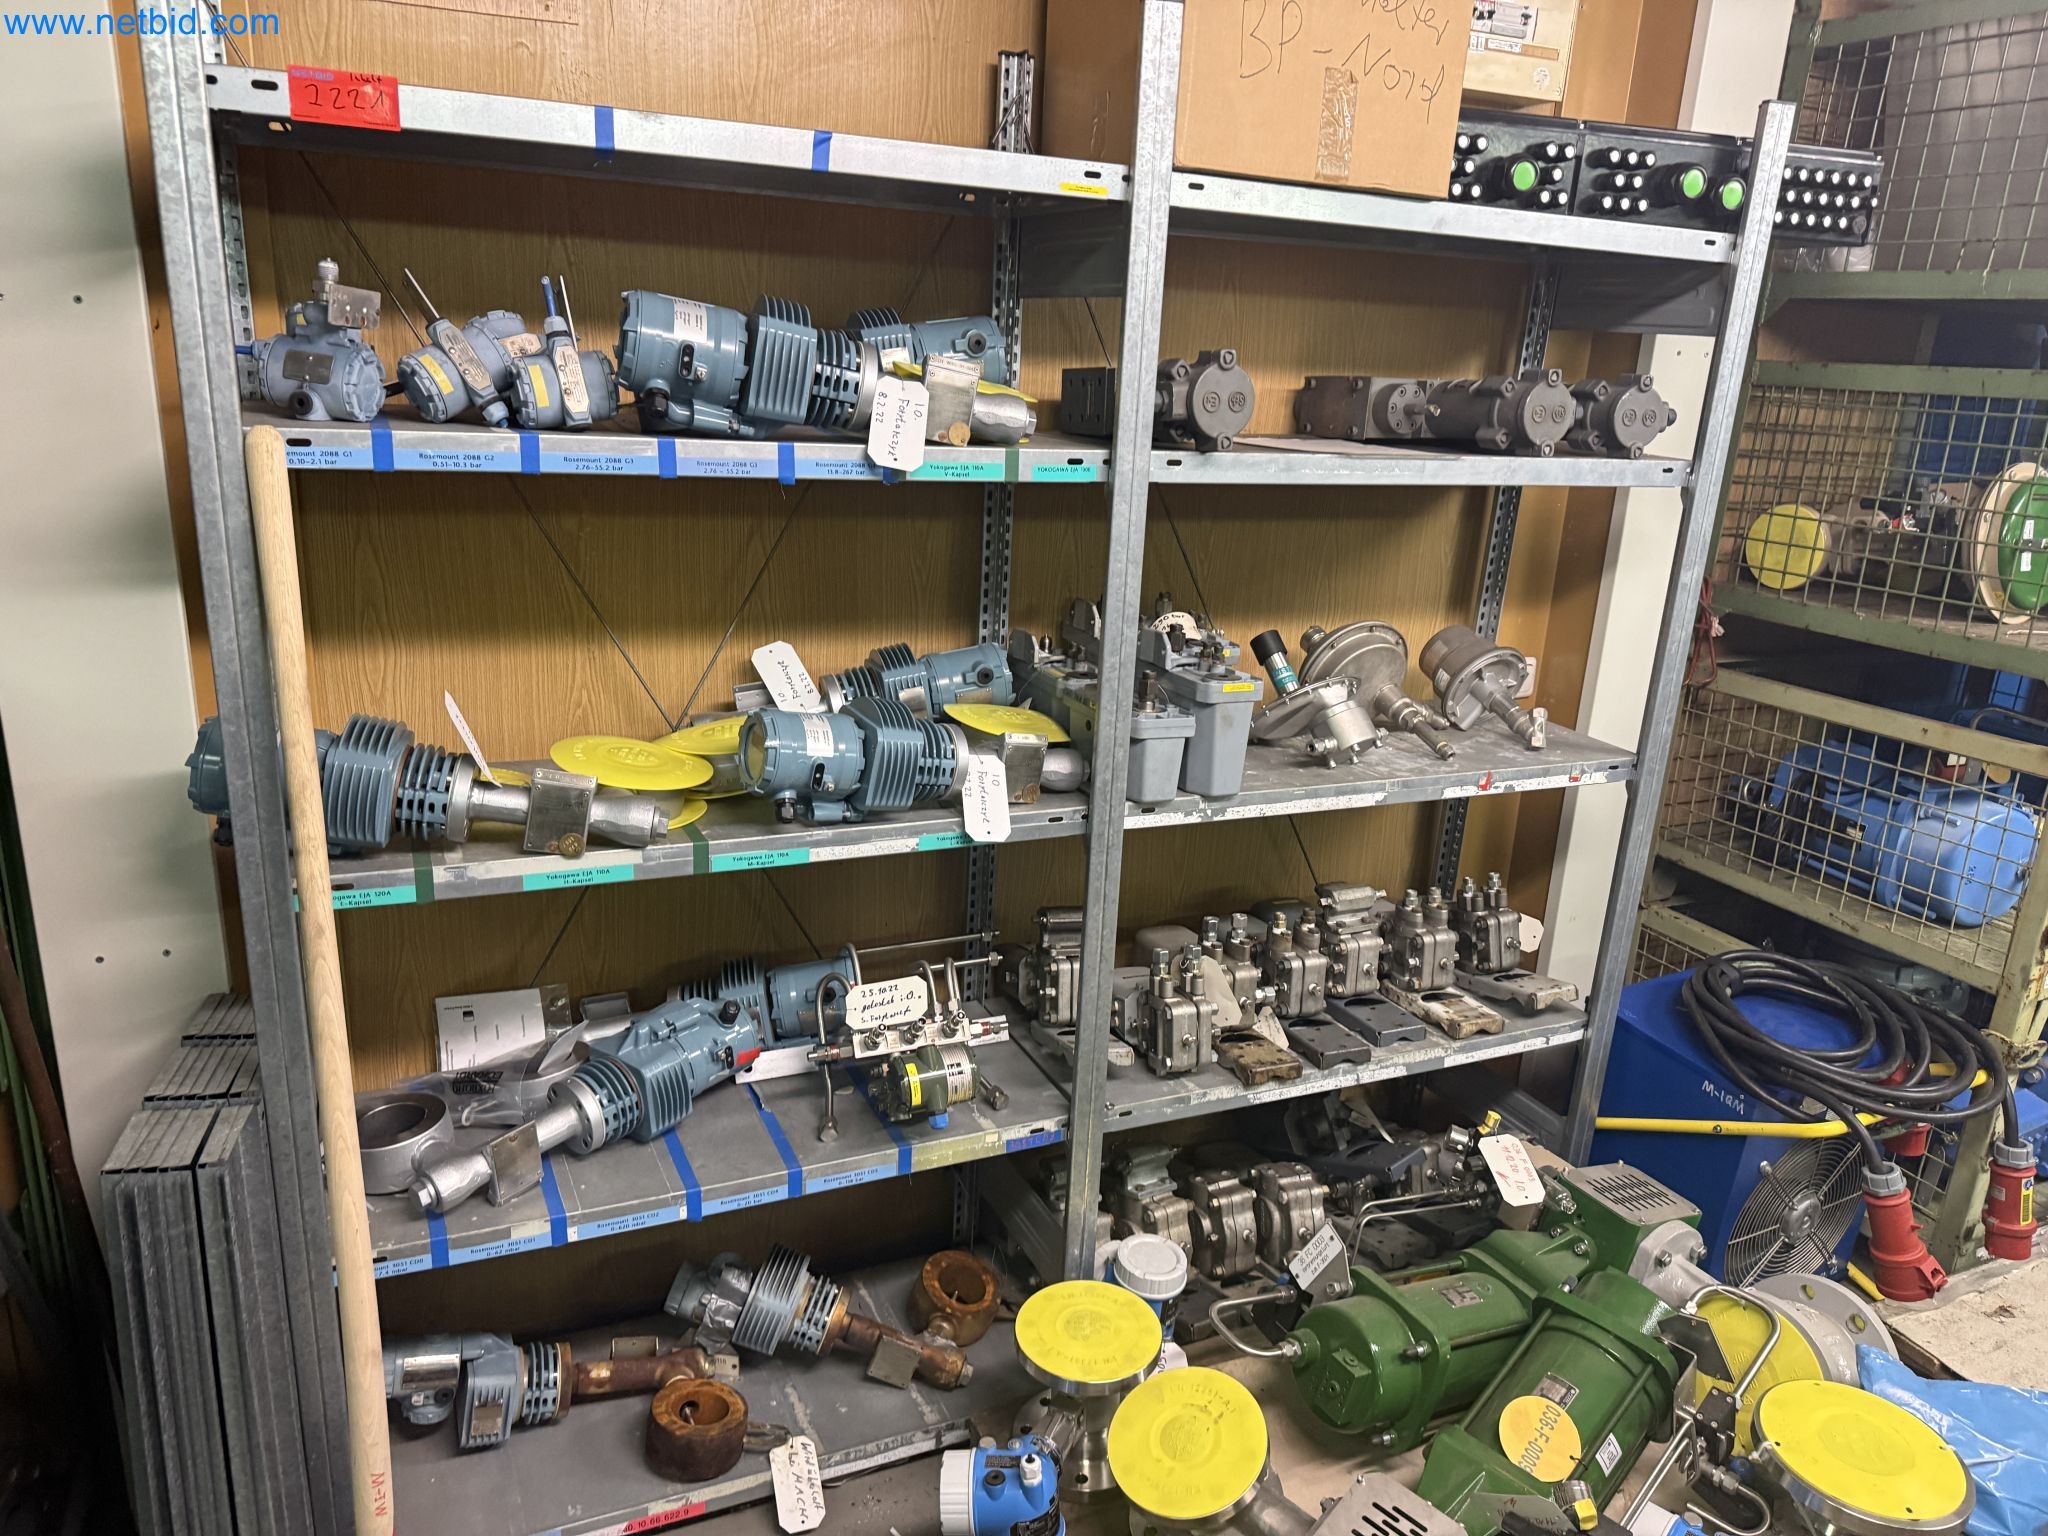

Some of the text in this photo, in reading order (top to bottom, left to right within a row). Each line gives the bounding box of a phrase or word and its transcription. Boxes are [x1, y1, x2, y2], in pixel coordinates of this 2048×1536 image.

[563, 456, 603, 464] Rosemount
[604, 456, 622, 464] 2088
[815, 461, 849, 469] Rosemount
[930, 464, 958, 472] Yokogawa
[747, 859, 775, 867] M-Kapsel
[545, 873, 577, 881] Yokogawa
[332, 893, 357, 902] ogawa
[823, 1174, 852, 1184] Rosemount
[720, 1195, 751, 1206] Rosemount
[597, 1218, 630, 1229] Rosemount
[631, 1220, 646, 1229] mbar
[470, 1243, 504, 1255] Rosemount
[506, 1240, 522, 1249] 3051
[504, 1246, 521, 1254] mbar
[391, 1267, 408, 1276] mbar
